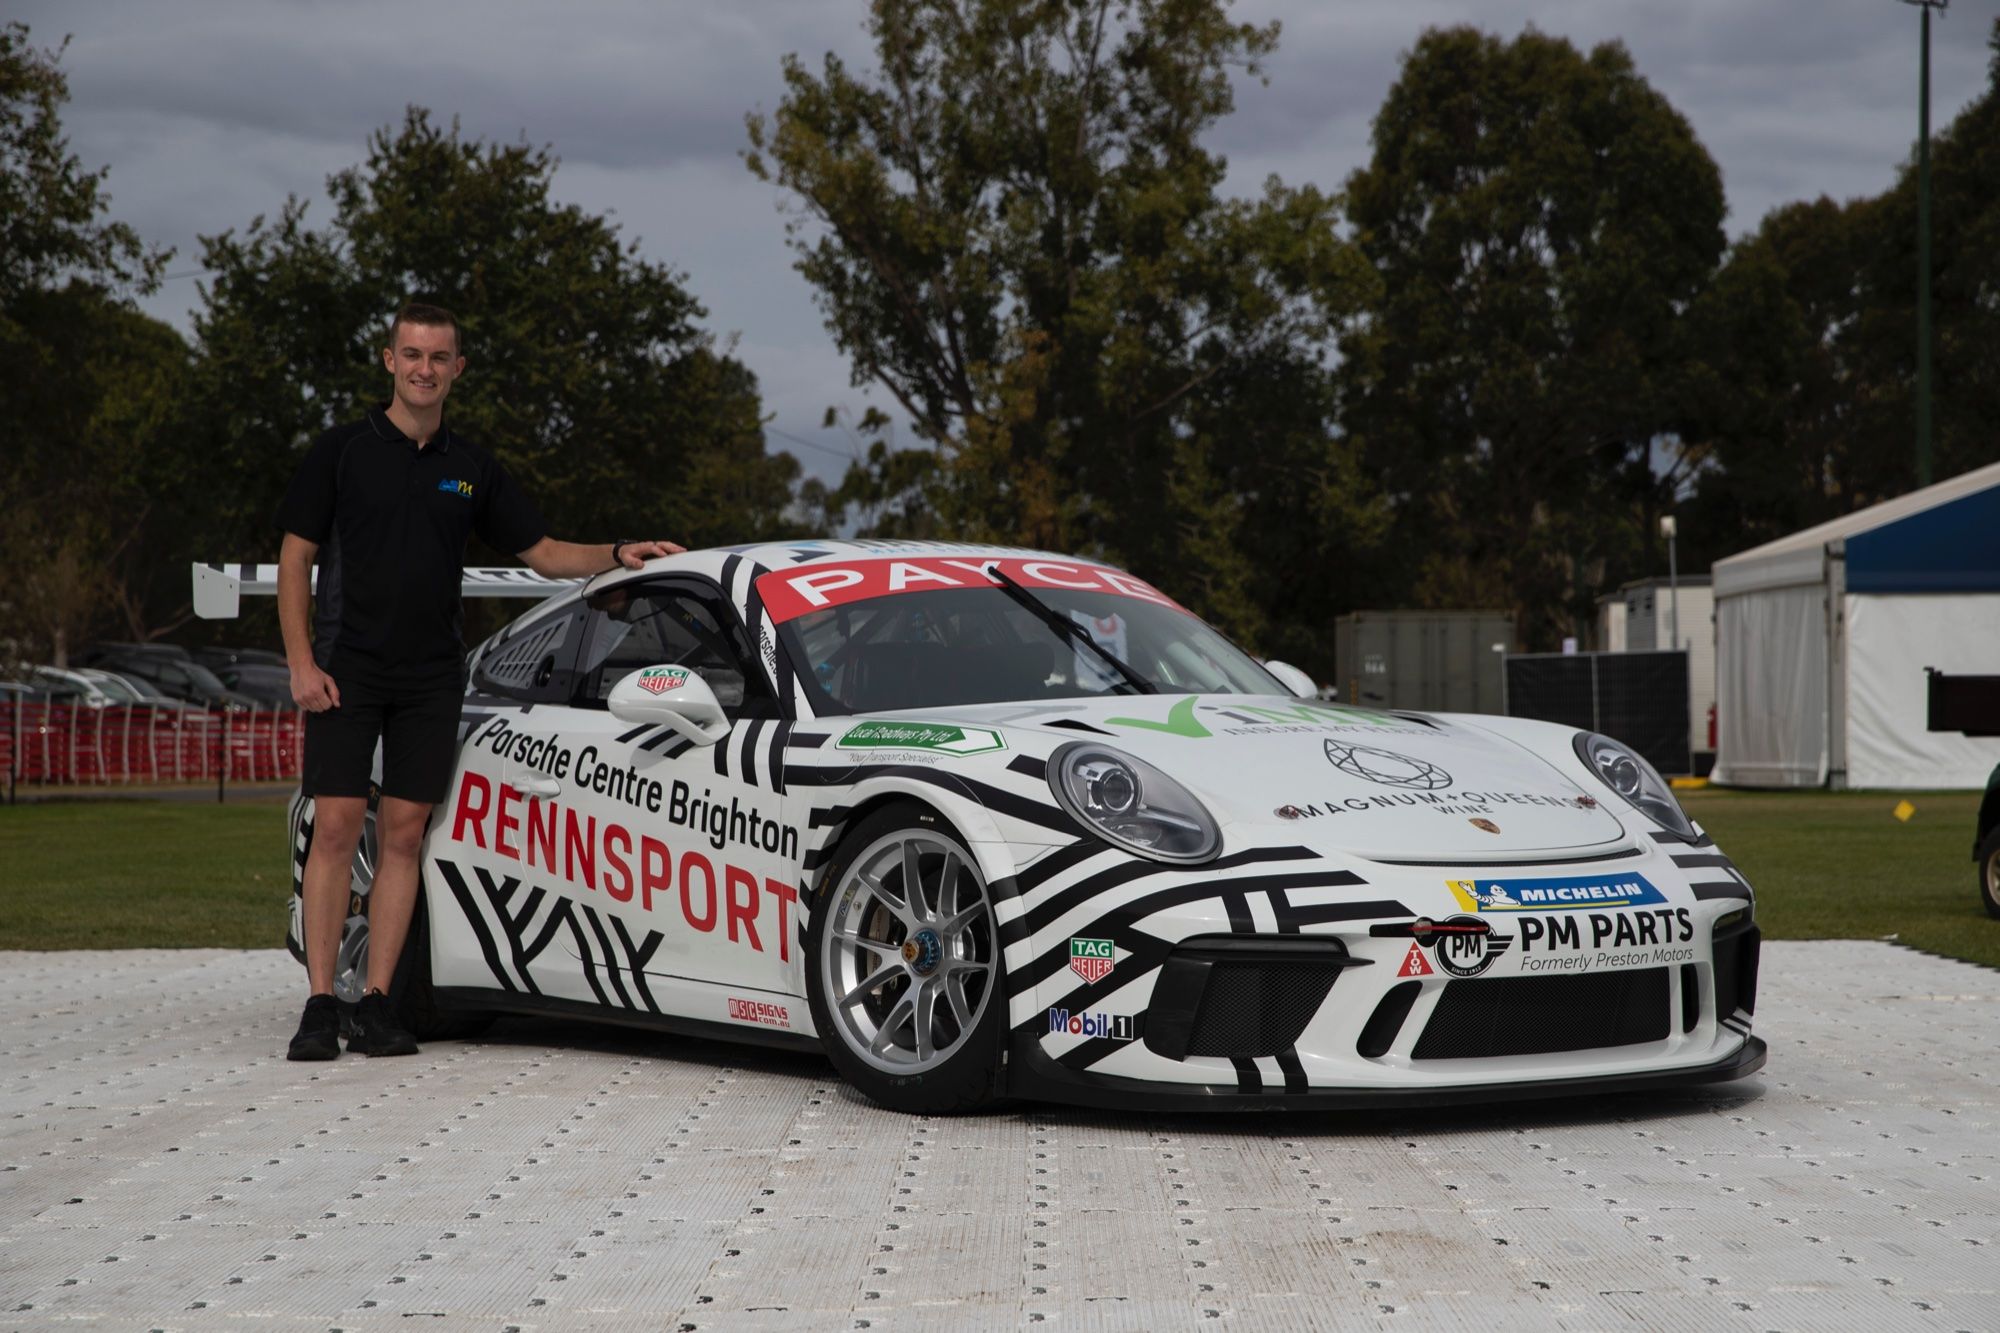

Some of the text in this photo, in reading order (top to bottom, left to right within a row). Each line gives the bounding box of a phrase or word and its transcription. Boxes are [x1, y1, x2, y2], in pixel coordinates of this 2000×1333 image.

[786, 560, 1173, 607] PAYCE
[647, 669, 683, 677] TAG
[640, 677, 682, 691] HEUER
[930, 731, 956, 742] Ltd
[474, 718, 798, 861] Porsche Centre Brighton
[1433, 805, 1494, 814] WINE
[451, 770, 798, 963] RENNSPORT
[1520, 883, 1643, 901] MICHELIN
[1517, 908, 1693, 951] PM PARTS
[1074, 941, 1110, 957] TAG
[1452, 935, 1481, 958] PM
[1409, 949, 1422, 975] TOW
[1520, 948, 1693, 971] Formerly Preston Motors
[1073, 959, 1111, 980] HEUER
[1451, 966, 1468, 975] SINCE
[757, 1003, 788, 1019] SIGNS
[759, 1017, 790, 1028] com.au
[1050, 1008, 1108, 1038] Mobil
